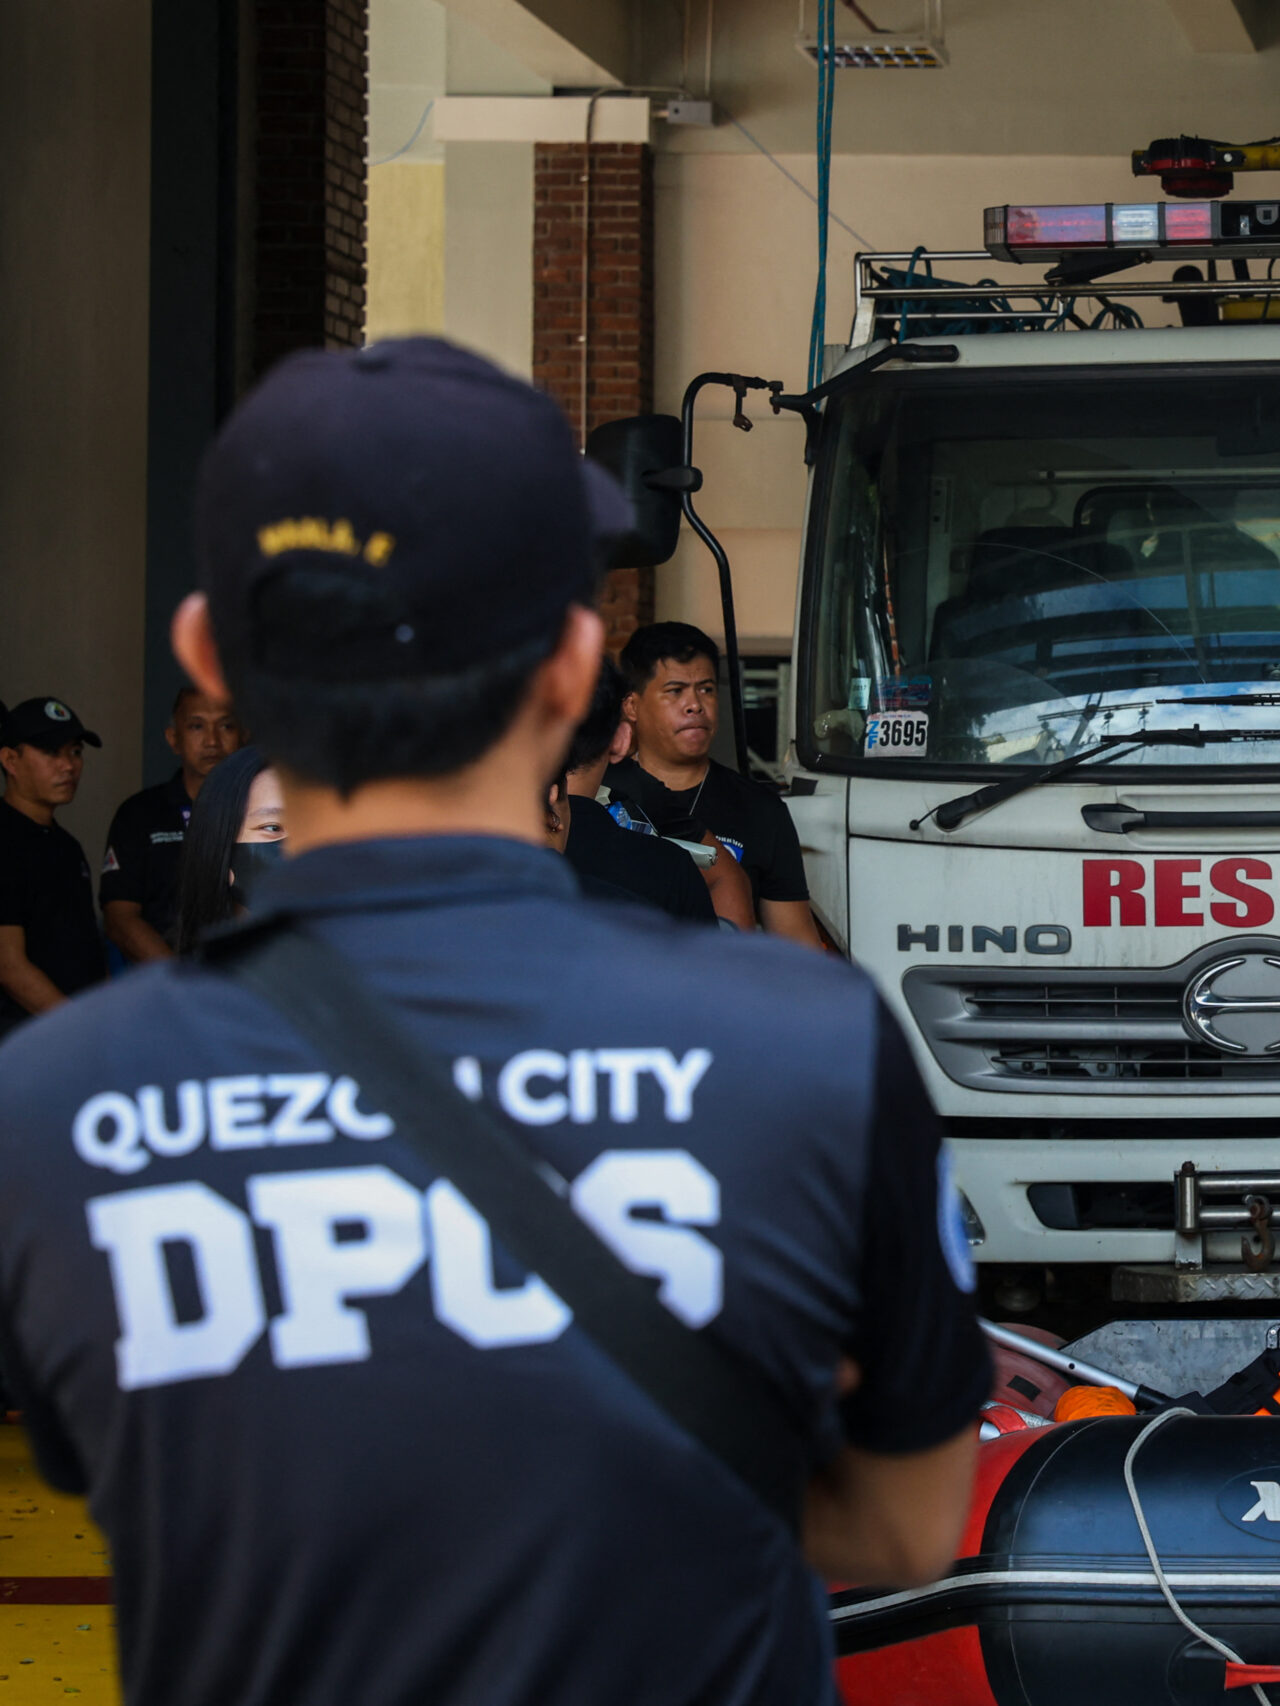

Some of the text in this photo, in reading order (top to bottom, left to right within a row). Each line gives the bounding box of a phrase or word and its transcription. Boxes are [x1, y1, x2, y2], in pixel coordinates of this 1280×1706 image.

[879, 720, 927, 747] 3695
[897, 923, 1073, 955] HINO
[72, 1047, 713, 1174] QUEZO CITY
